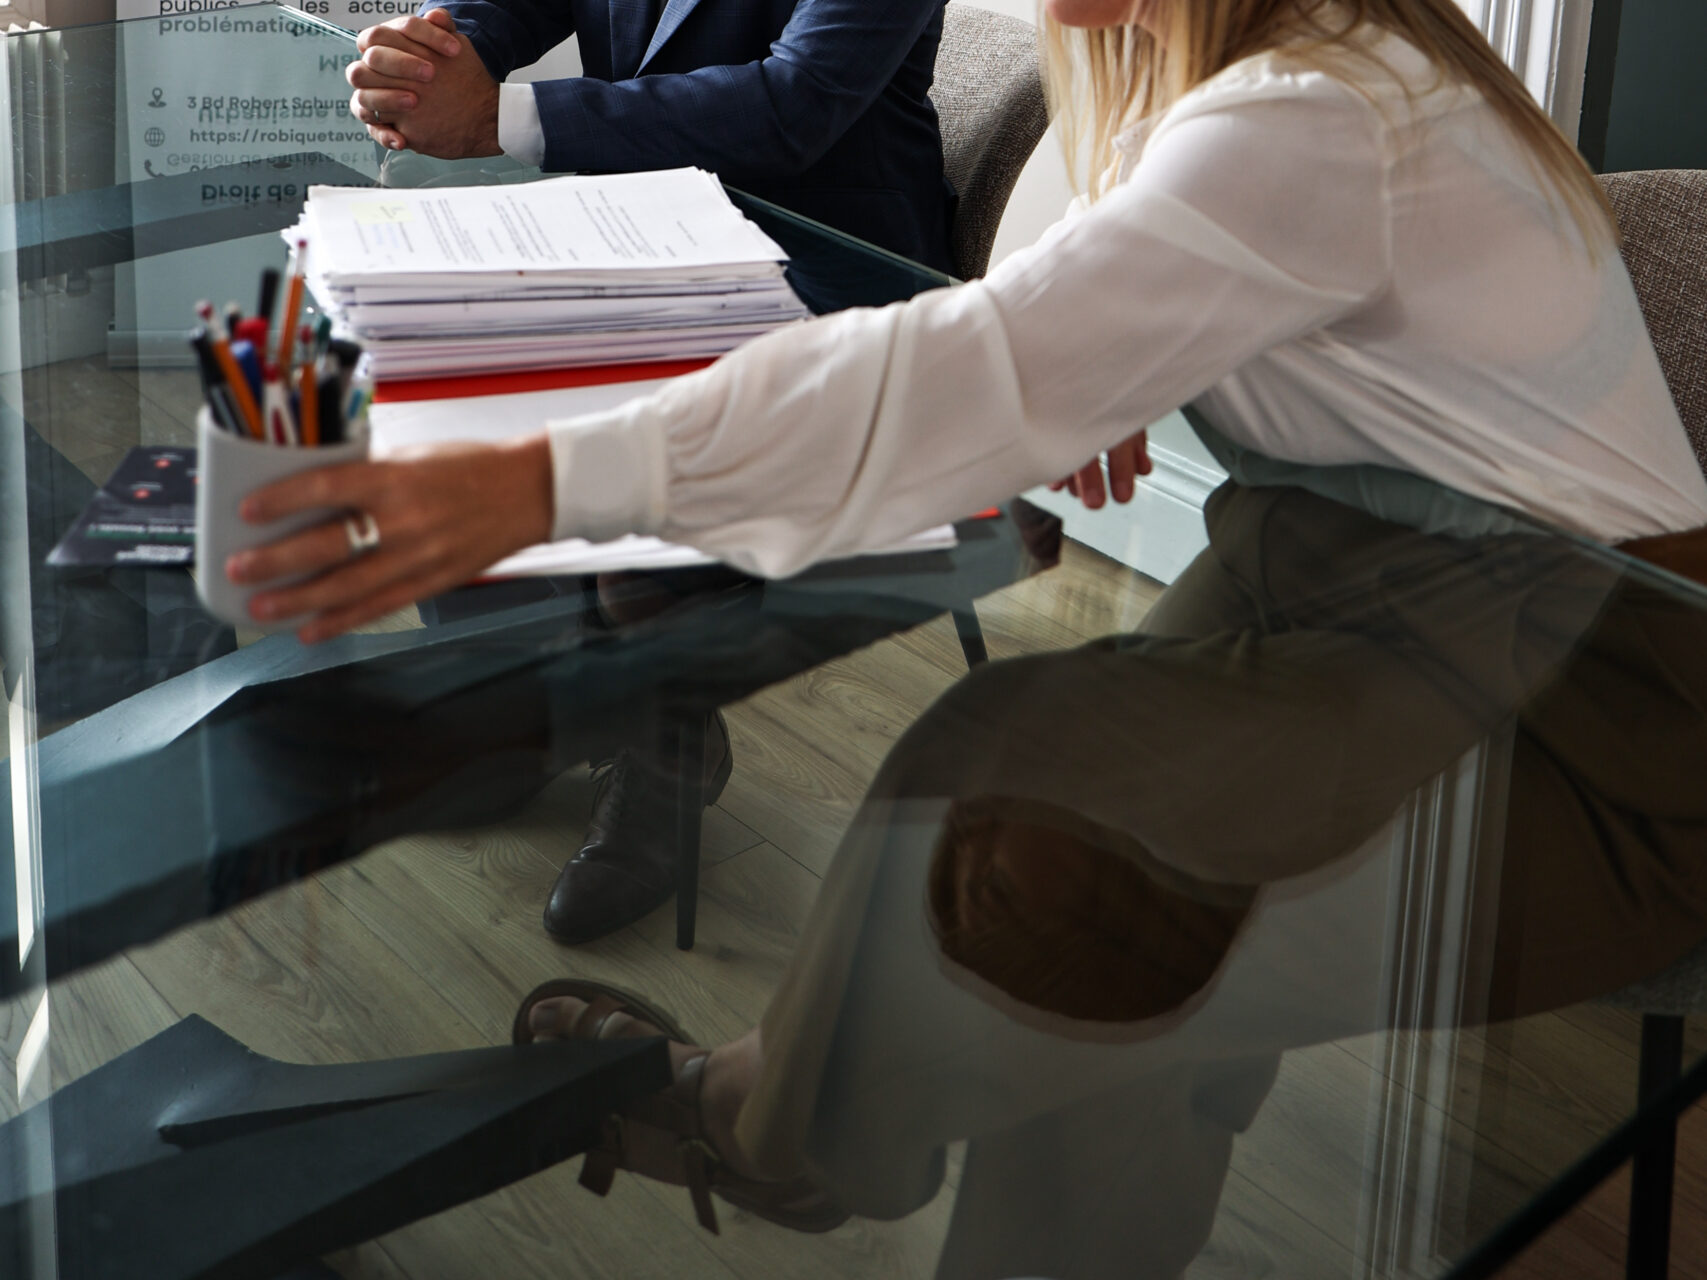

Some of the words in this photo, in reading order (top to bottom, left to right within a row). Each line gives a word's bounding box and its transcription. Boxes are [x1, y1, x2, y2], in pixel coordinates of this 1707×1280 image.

[348, 0, 424, 14] acteur
[187, 97, 197, 109] 3
[202, 96, 224, 109] Bd
[229, 97, 287, 110] Robert
